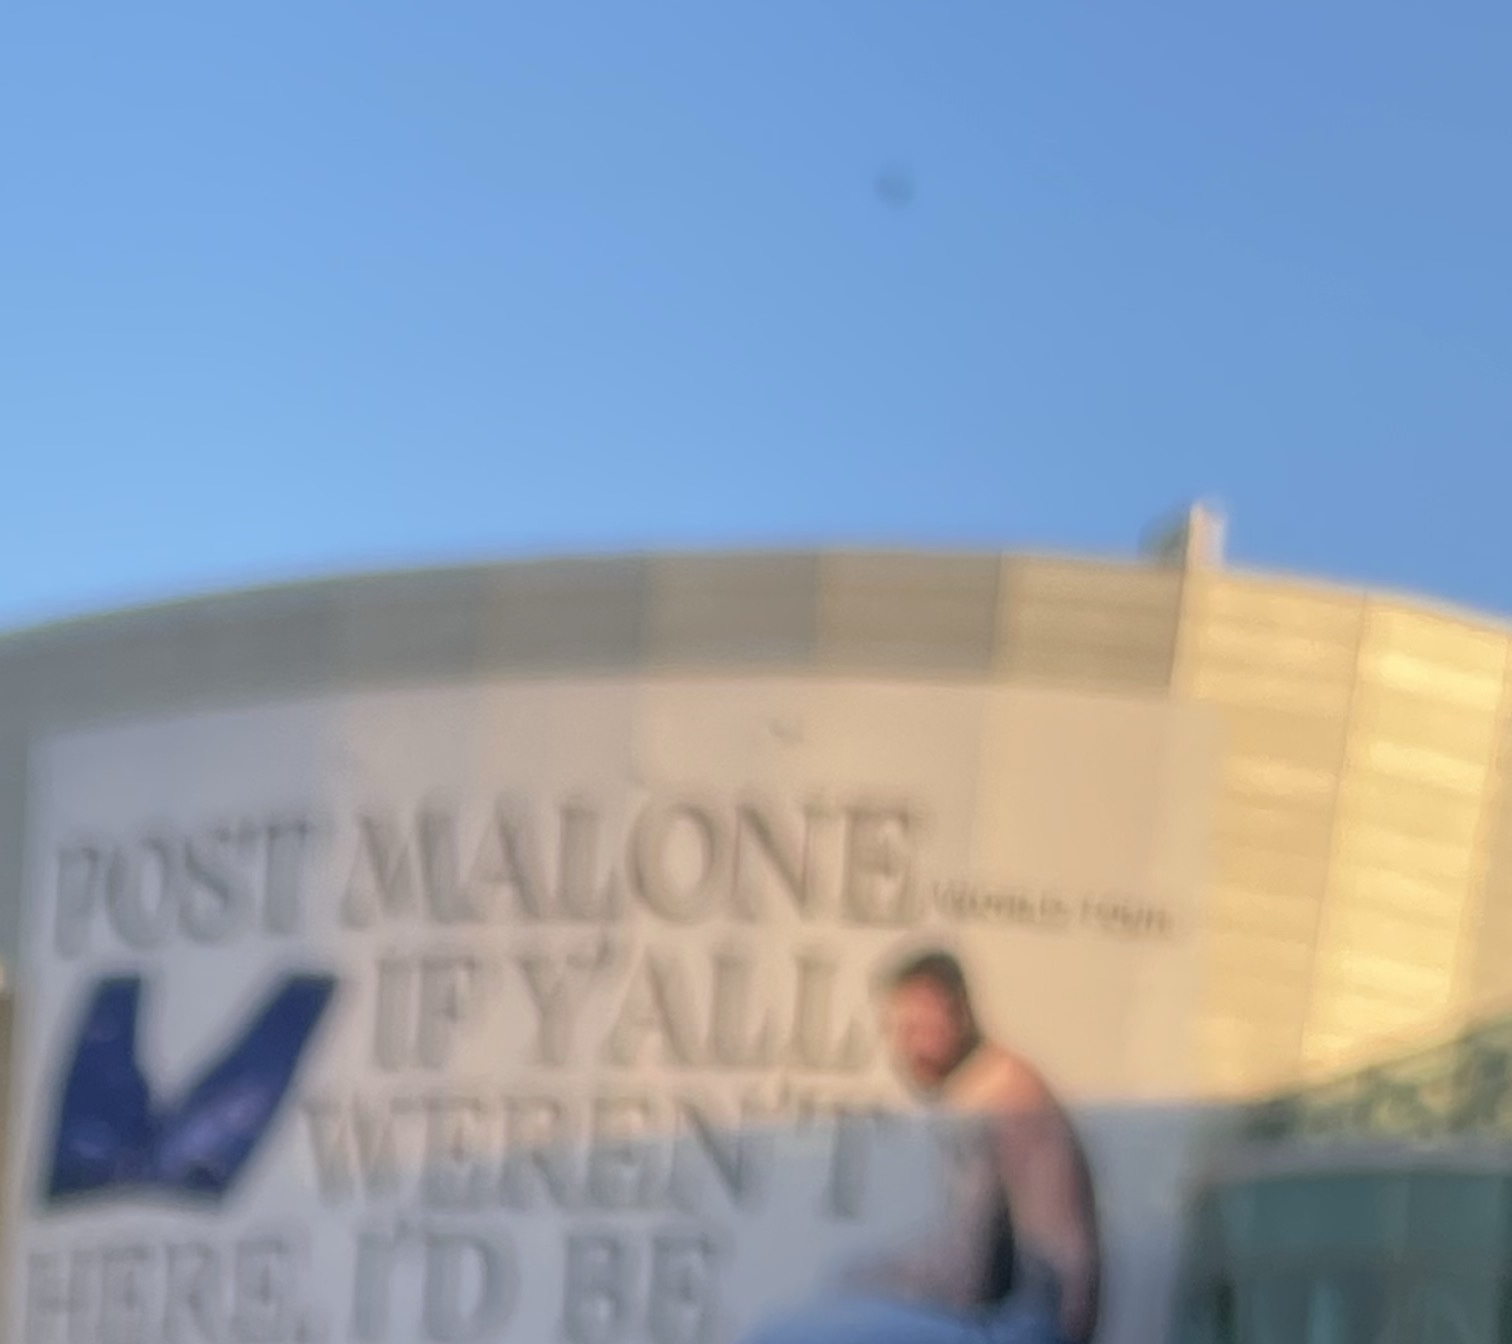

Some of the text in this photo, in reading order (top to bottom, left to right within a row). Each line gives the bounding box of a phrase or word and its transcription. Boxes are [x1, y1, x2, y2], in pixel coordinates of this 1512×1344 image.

[53, 792, 926, 962] POST MALONE
[376, 942, 876, 1073] IF Y'ALL
[296, 1095, 891, 1220] WEREN'T
